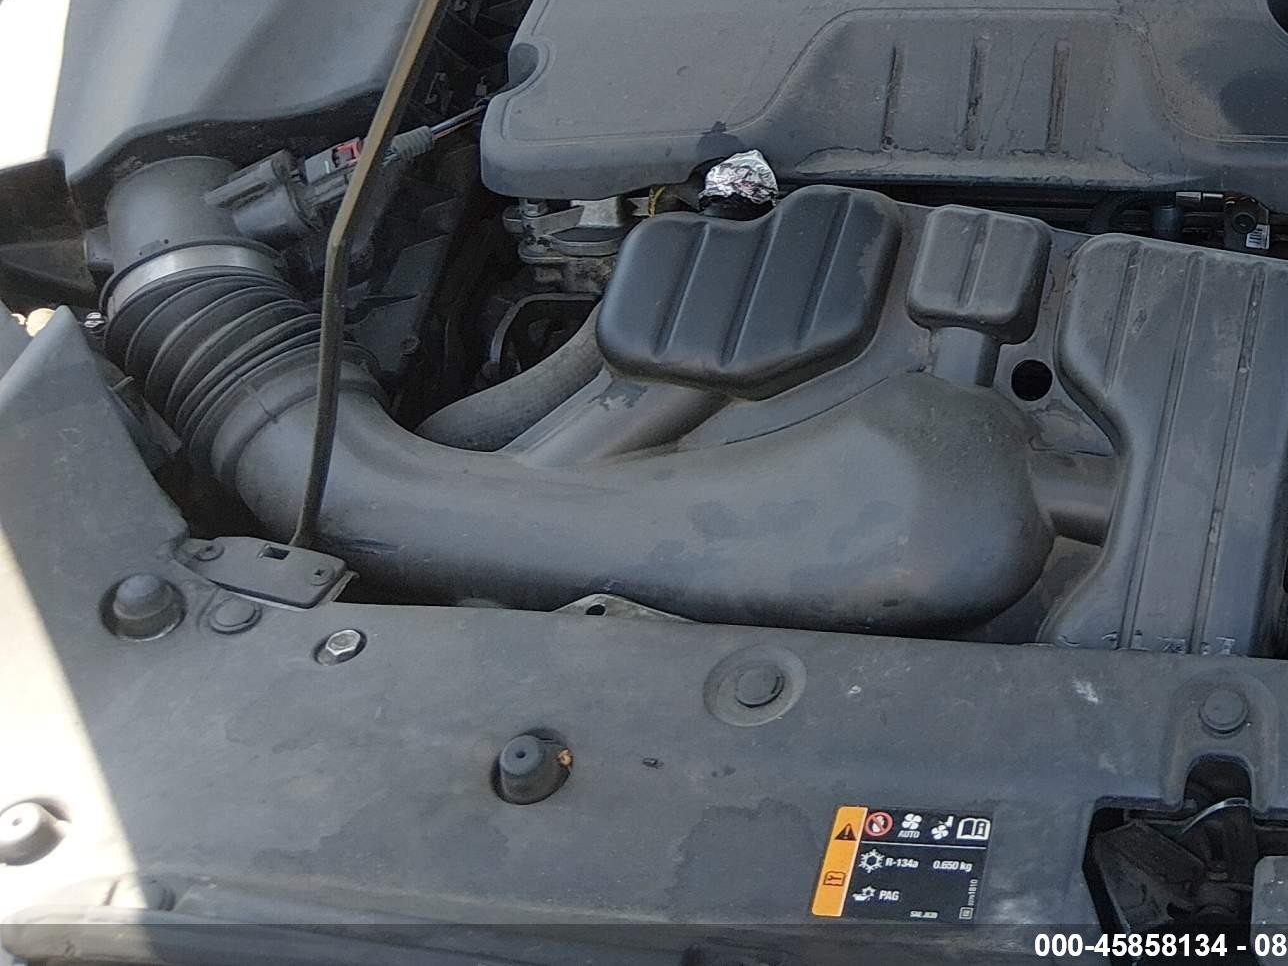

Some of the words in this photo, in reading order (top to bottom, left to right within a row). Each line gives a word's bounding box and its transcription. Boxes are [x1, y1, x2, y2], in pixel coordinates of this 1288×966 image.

[898, 830, 920, 839] AUTO
[885, 857, 919, 869] R-134a
[932, 860, 959, 870] 0.650
[960, 861, 973, 873] kg
[878, 889, 900, 901] PAG
